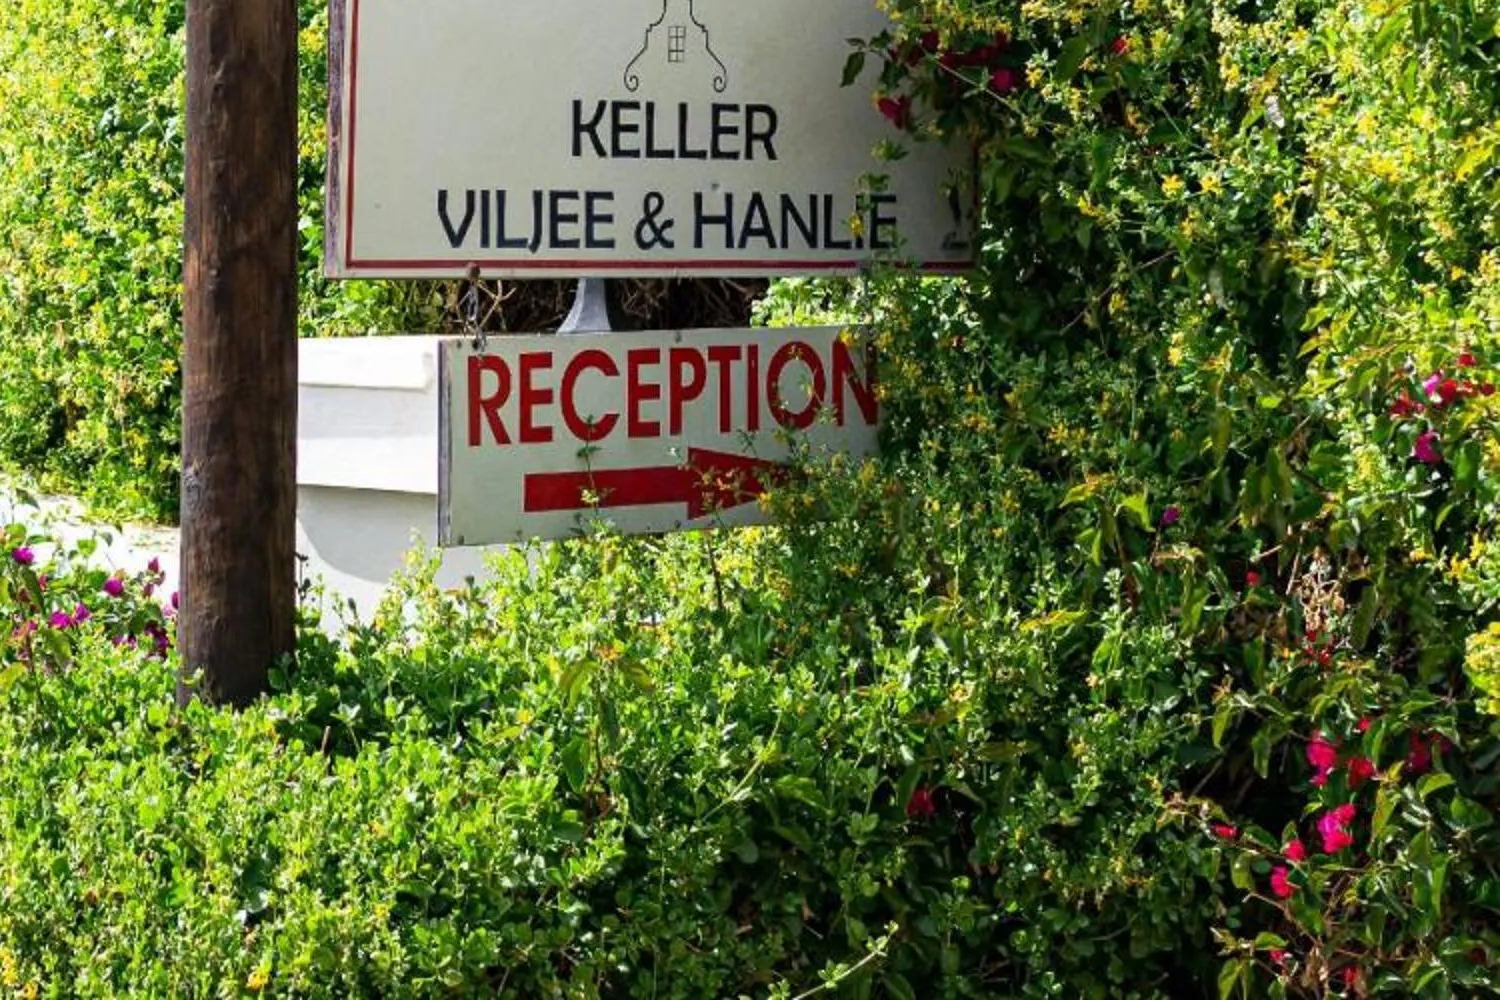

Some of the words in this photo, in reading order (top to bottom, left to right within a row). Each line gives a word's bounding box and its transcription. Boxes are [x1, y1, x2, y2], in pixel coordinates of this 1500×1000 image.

[571, 99, 779, 161] KELLER
[437, 189, 616, 254] VILJEE
[634, 191, 676, 250] &
[692, 191, 897, 250] HANLIE
[467, 340, 878, 446] RECEPTION
